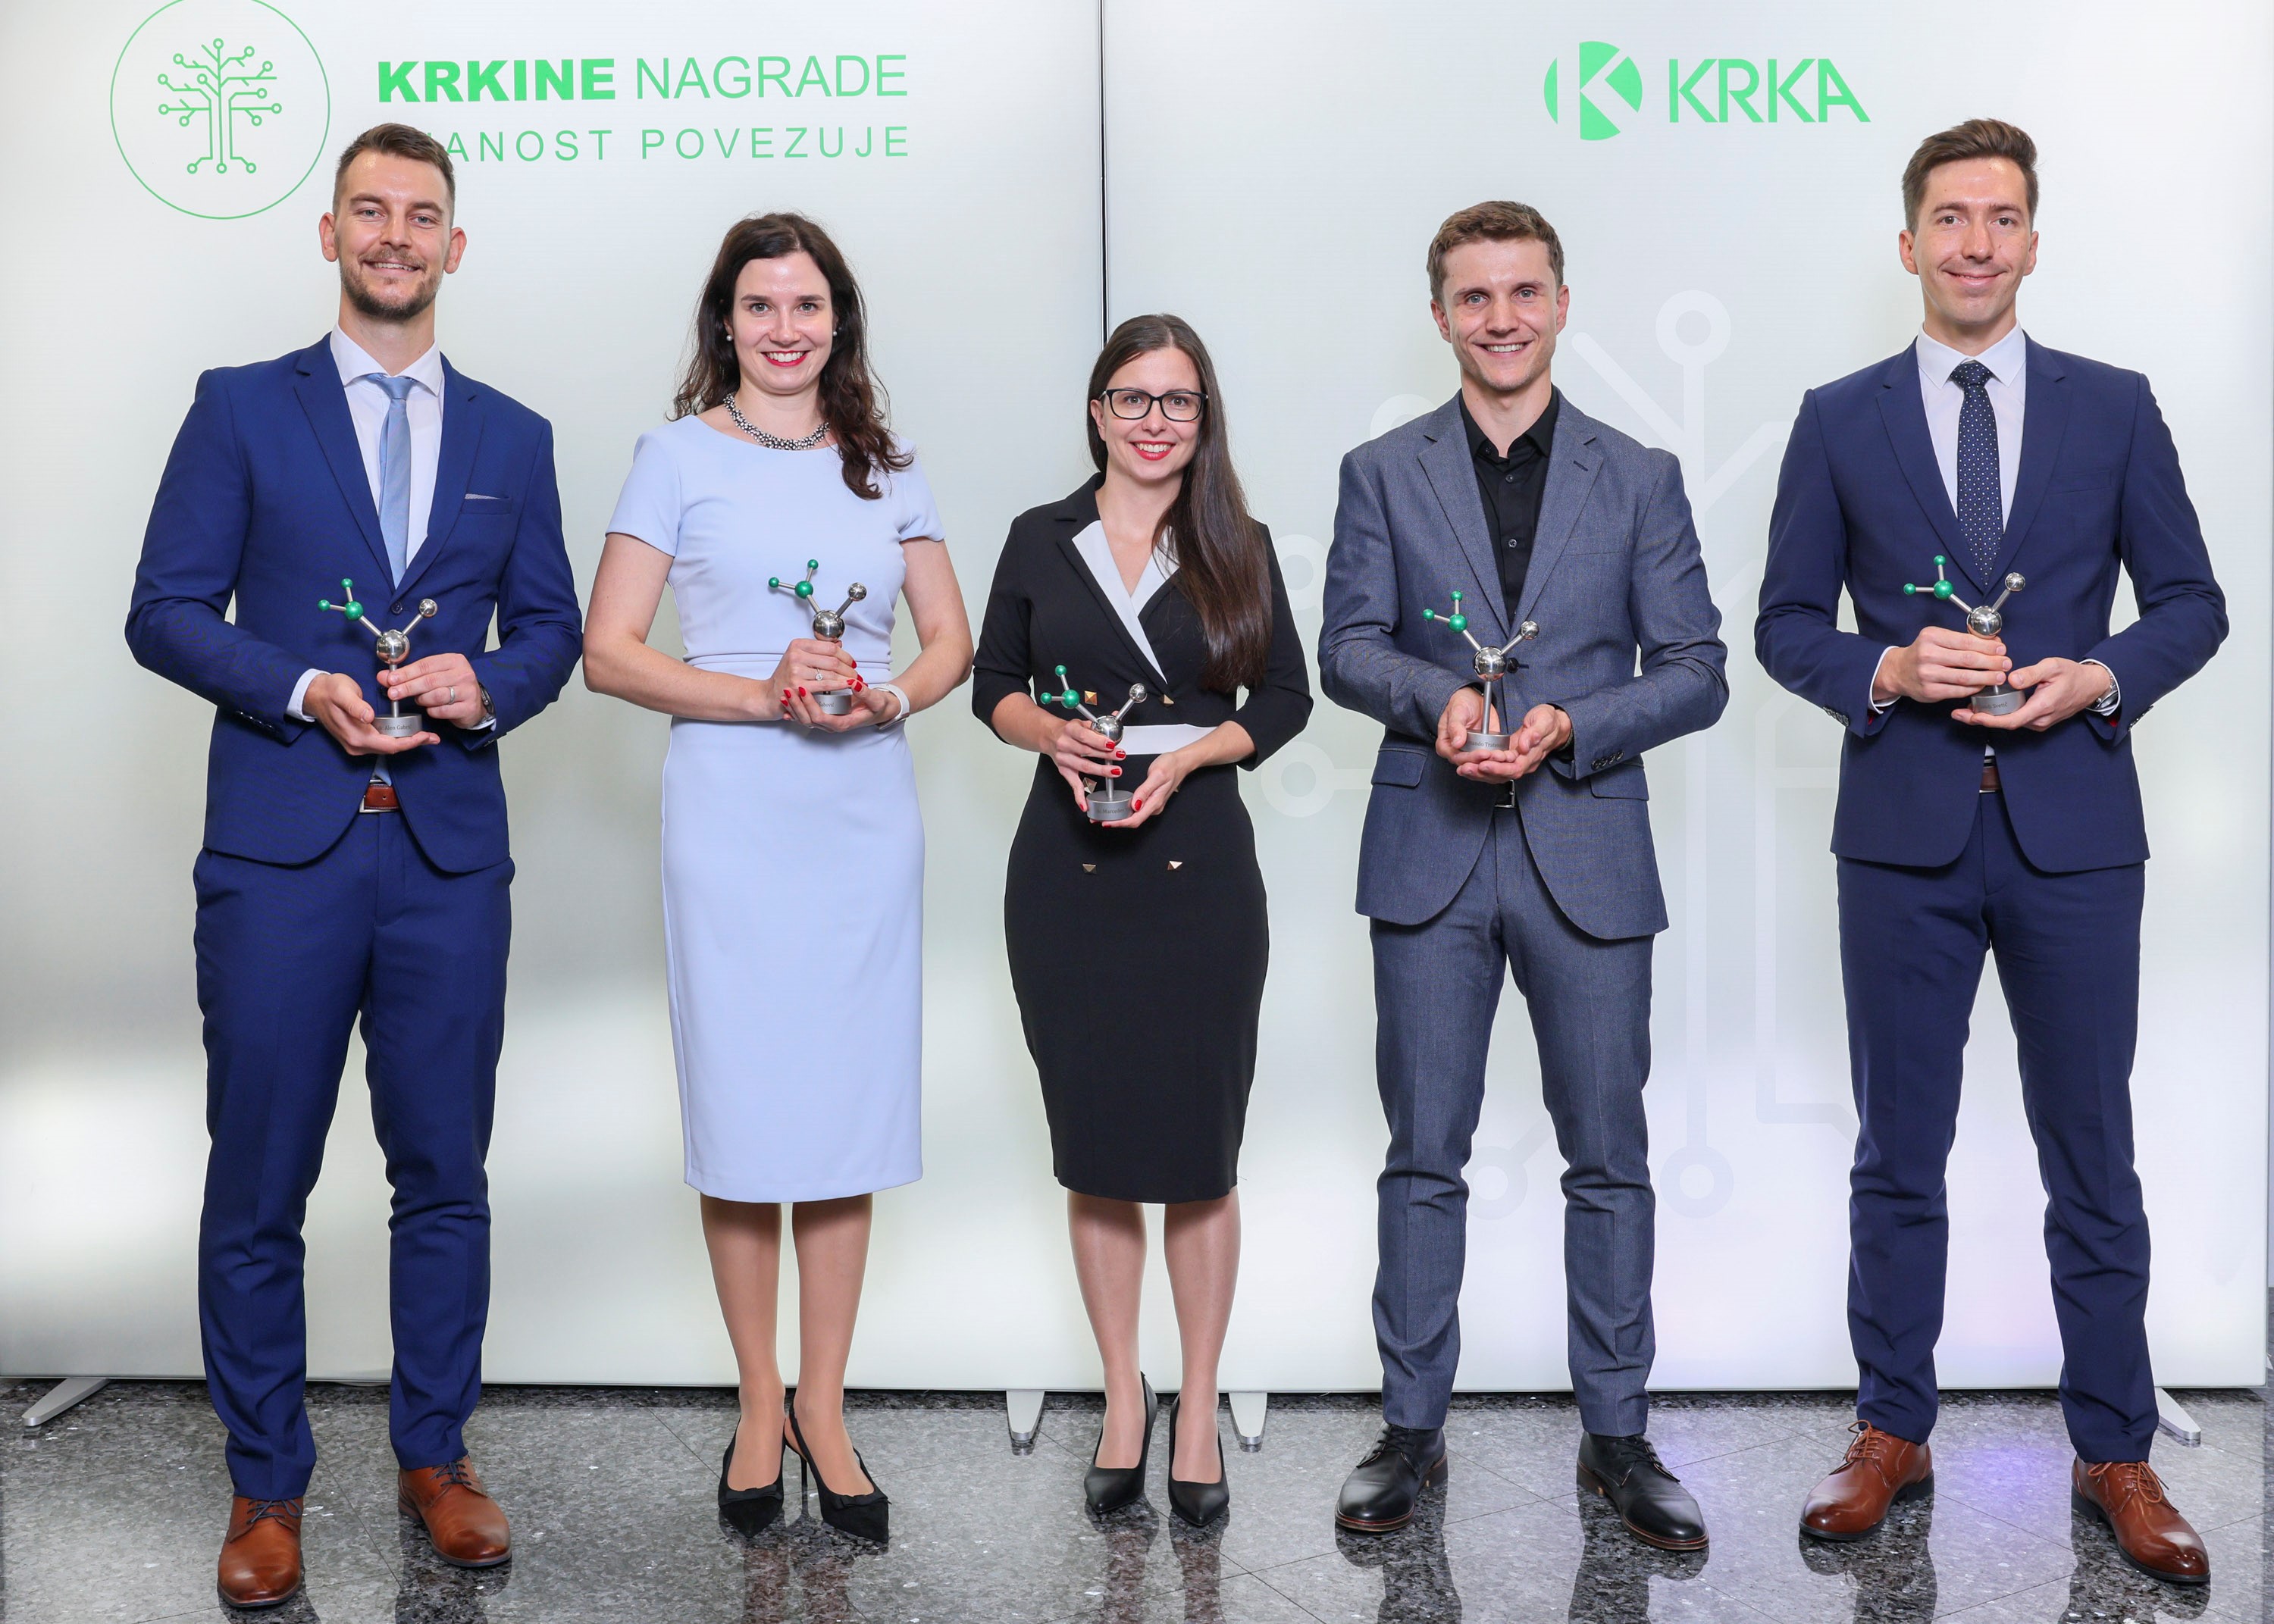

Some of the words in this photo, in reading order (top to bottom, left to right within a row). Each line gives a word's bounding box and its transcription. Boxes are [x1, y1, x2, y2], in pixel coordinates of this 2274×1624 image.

[378, 58, 615, 102] KRKINE
[637, 55, 908, 99] NAGRADE
[1668, 58, 1871, 123] KRKA
[428, 130, 612, 161] ANOST
[642, 126, 908, 159] POVEZUJE
